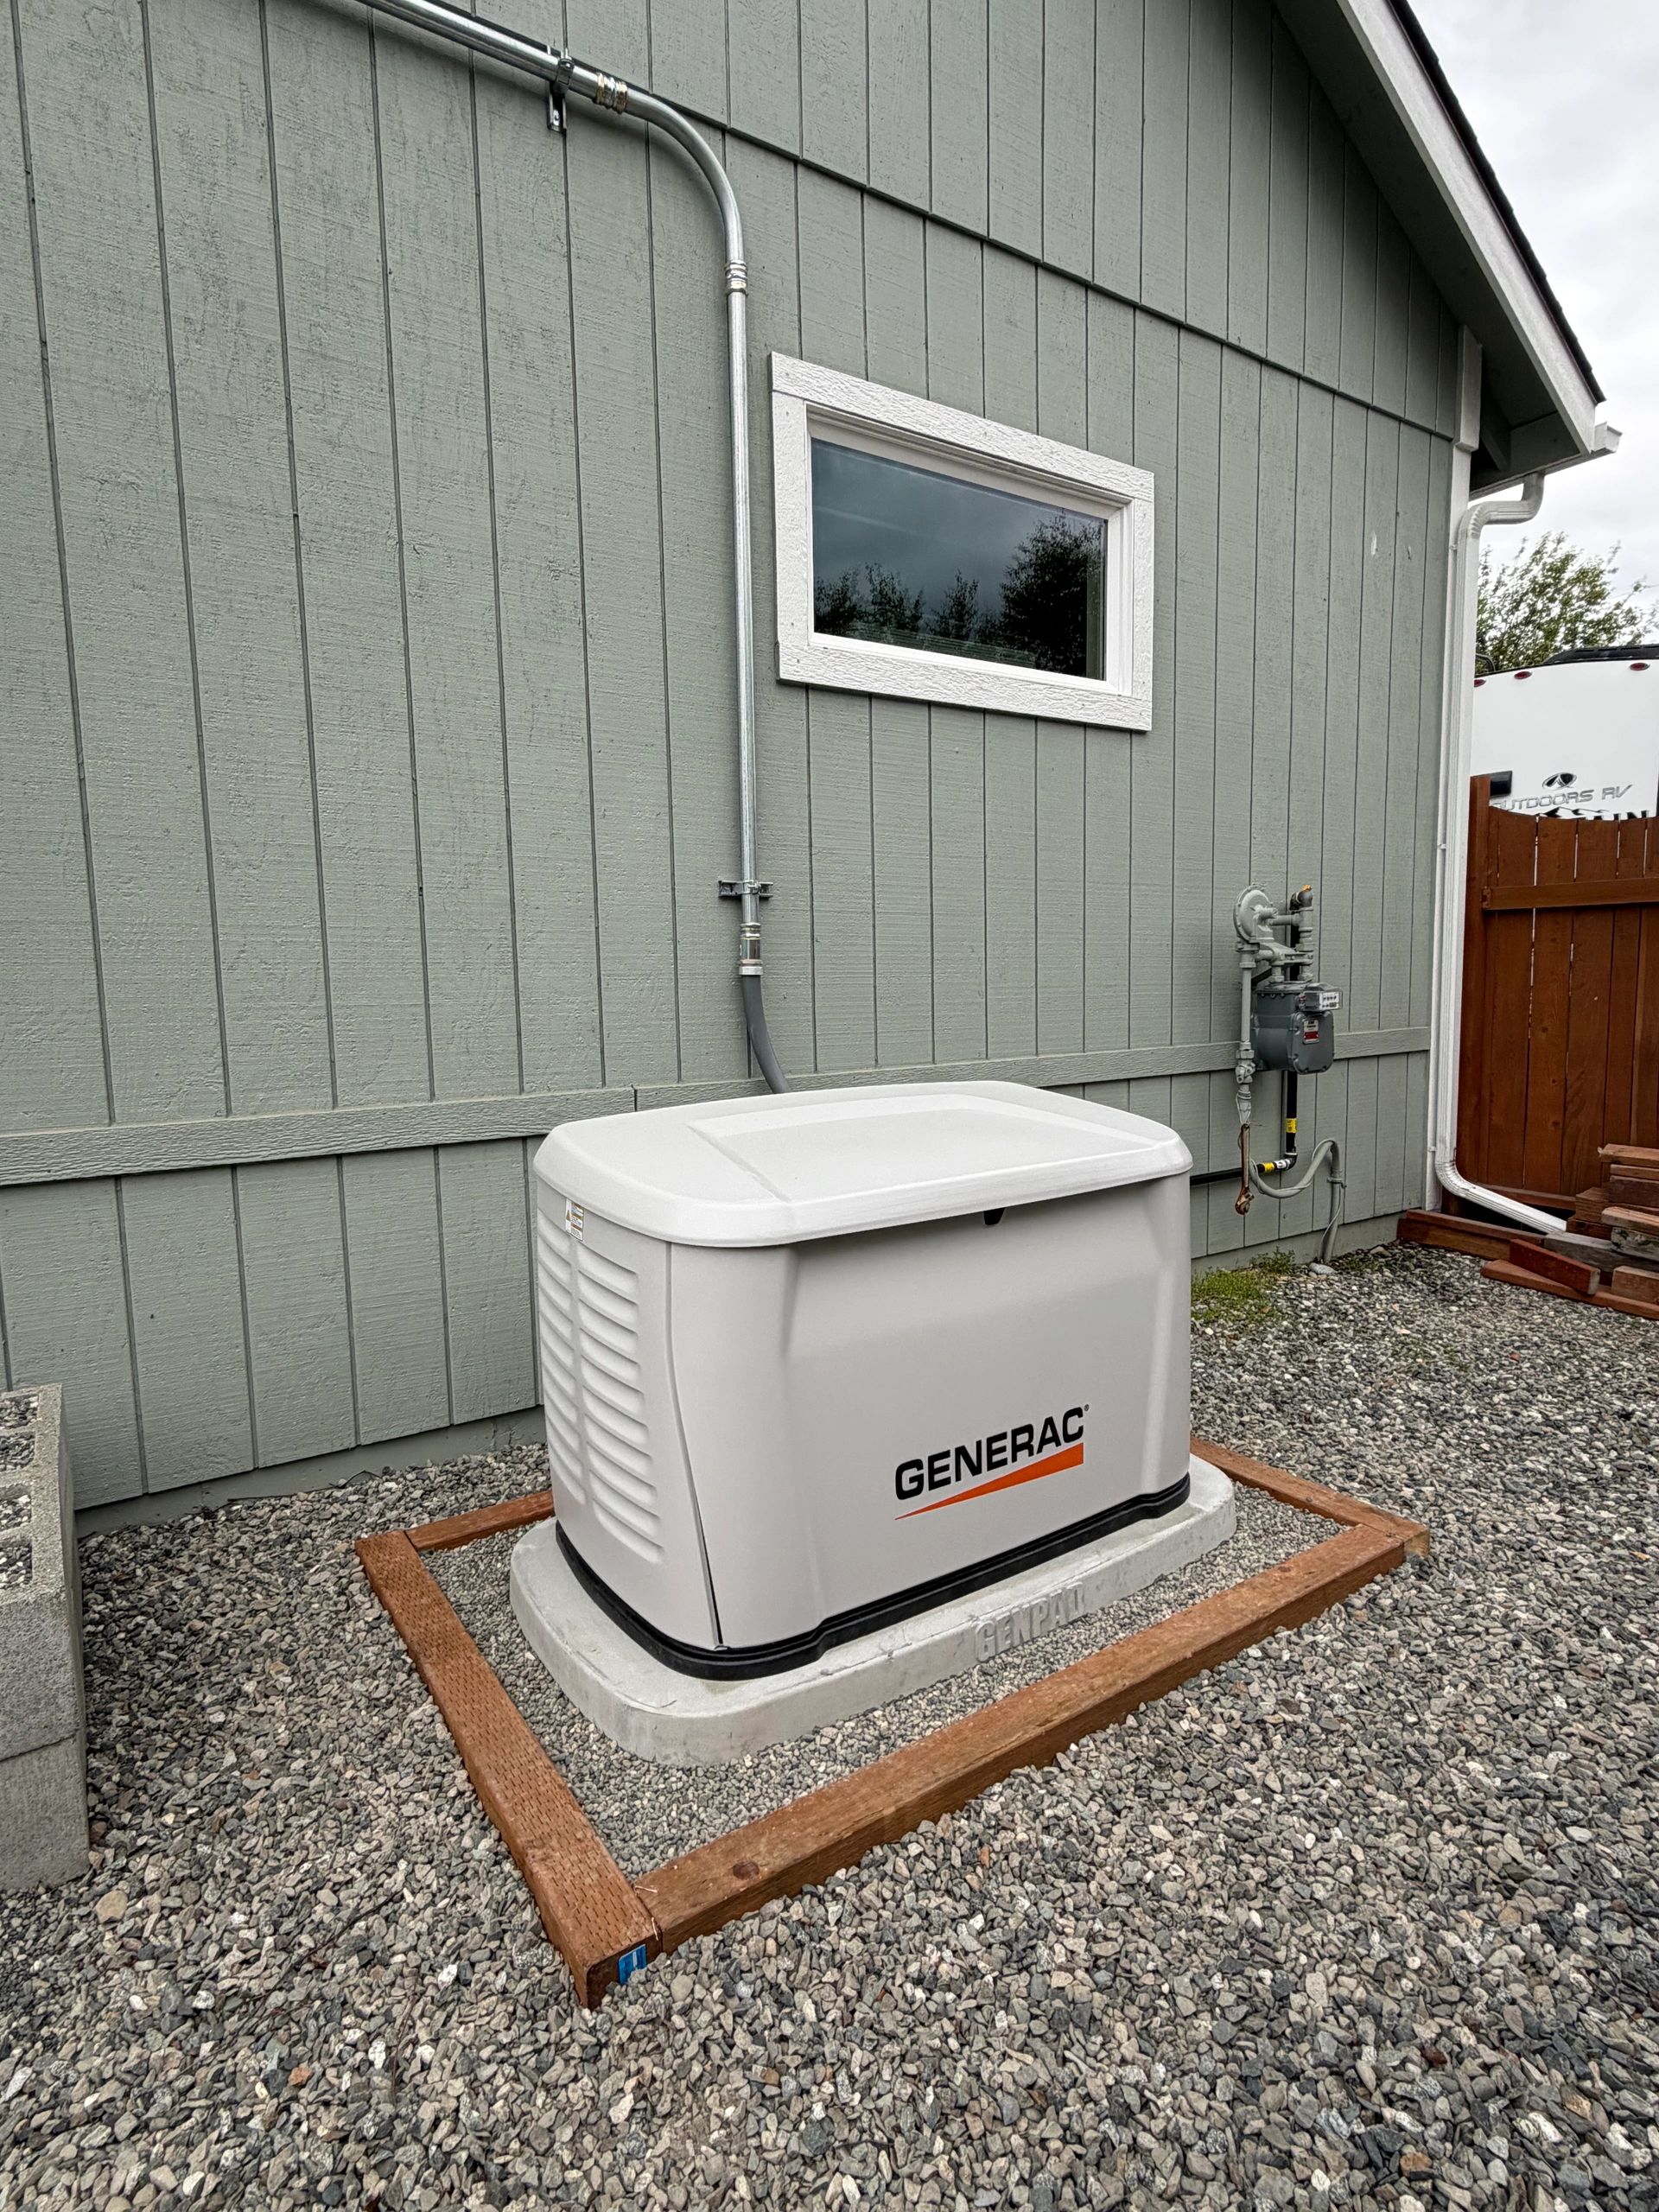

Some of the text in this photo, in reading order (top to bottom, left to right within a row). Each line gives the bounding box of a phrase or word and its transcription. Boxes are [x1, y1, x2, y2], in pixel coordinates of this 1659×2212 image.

[1601, 784, 1633, 800] RV
[894, 1406, 1084, 1501] GENERAC
[975, 1581, 1086, 1663] GENPAD
